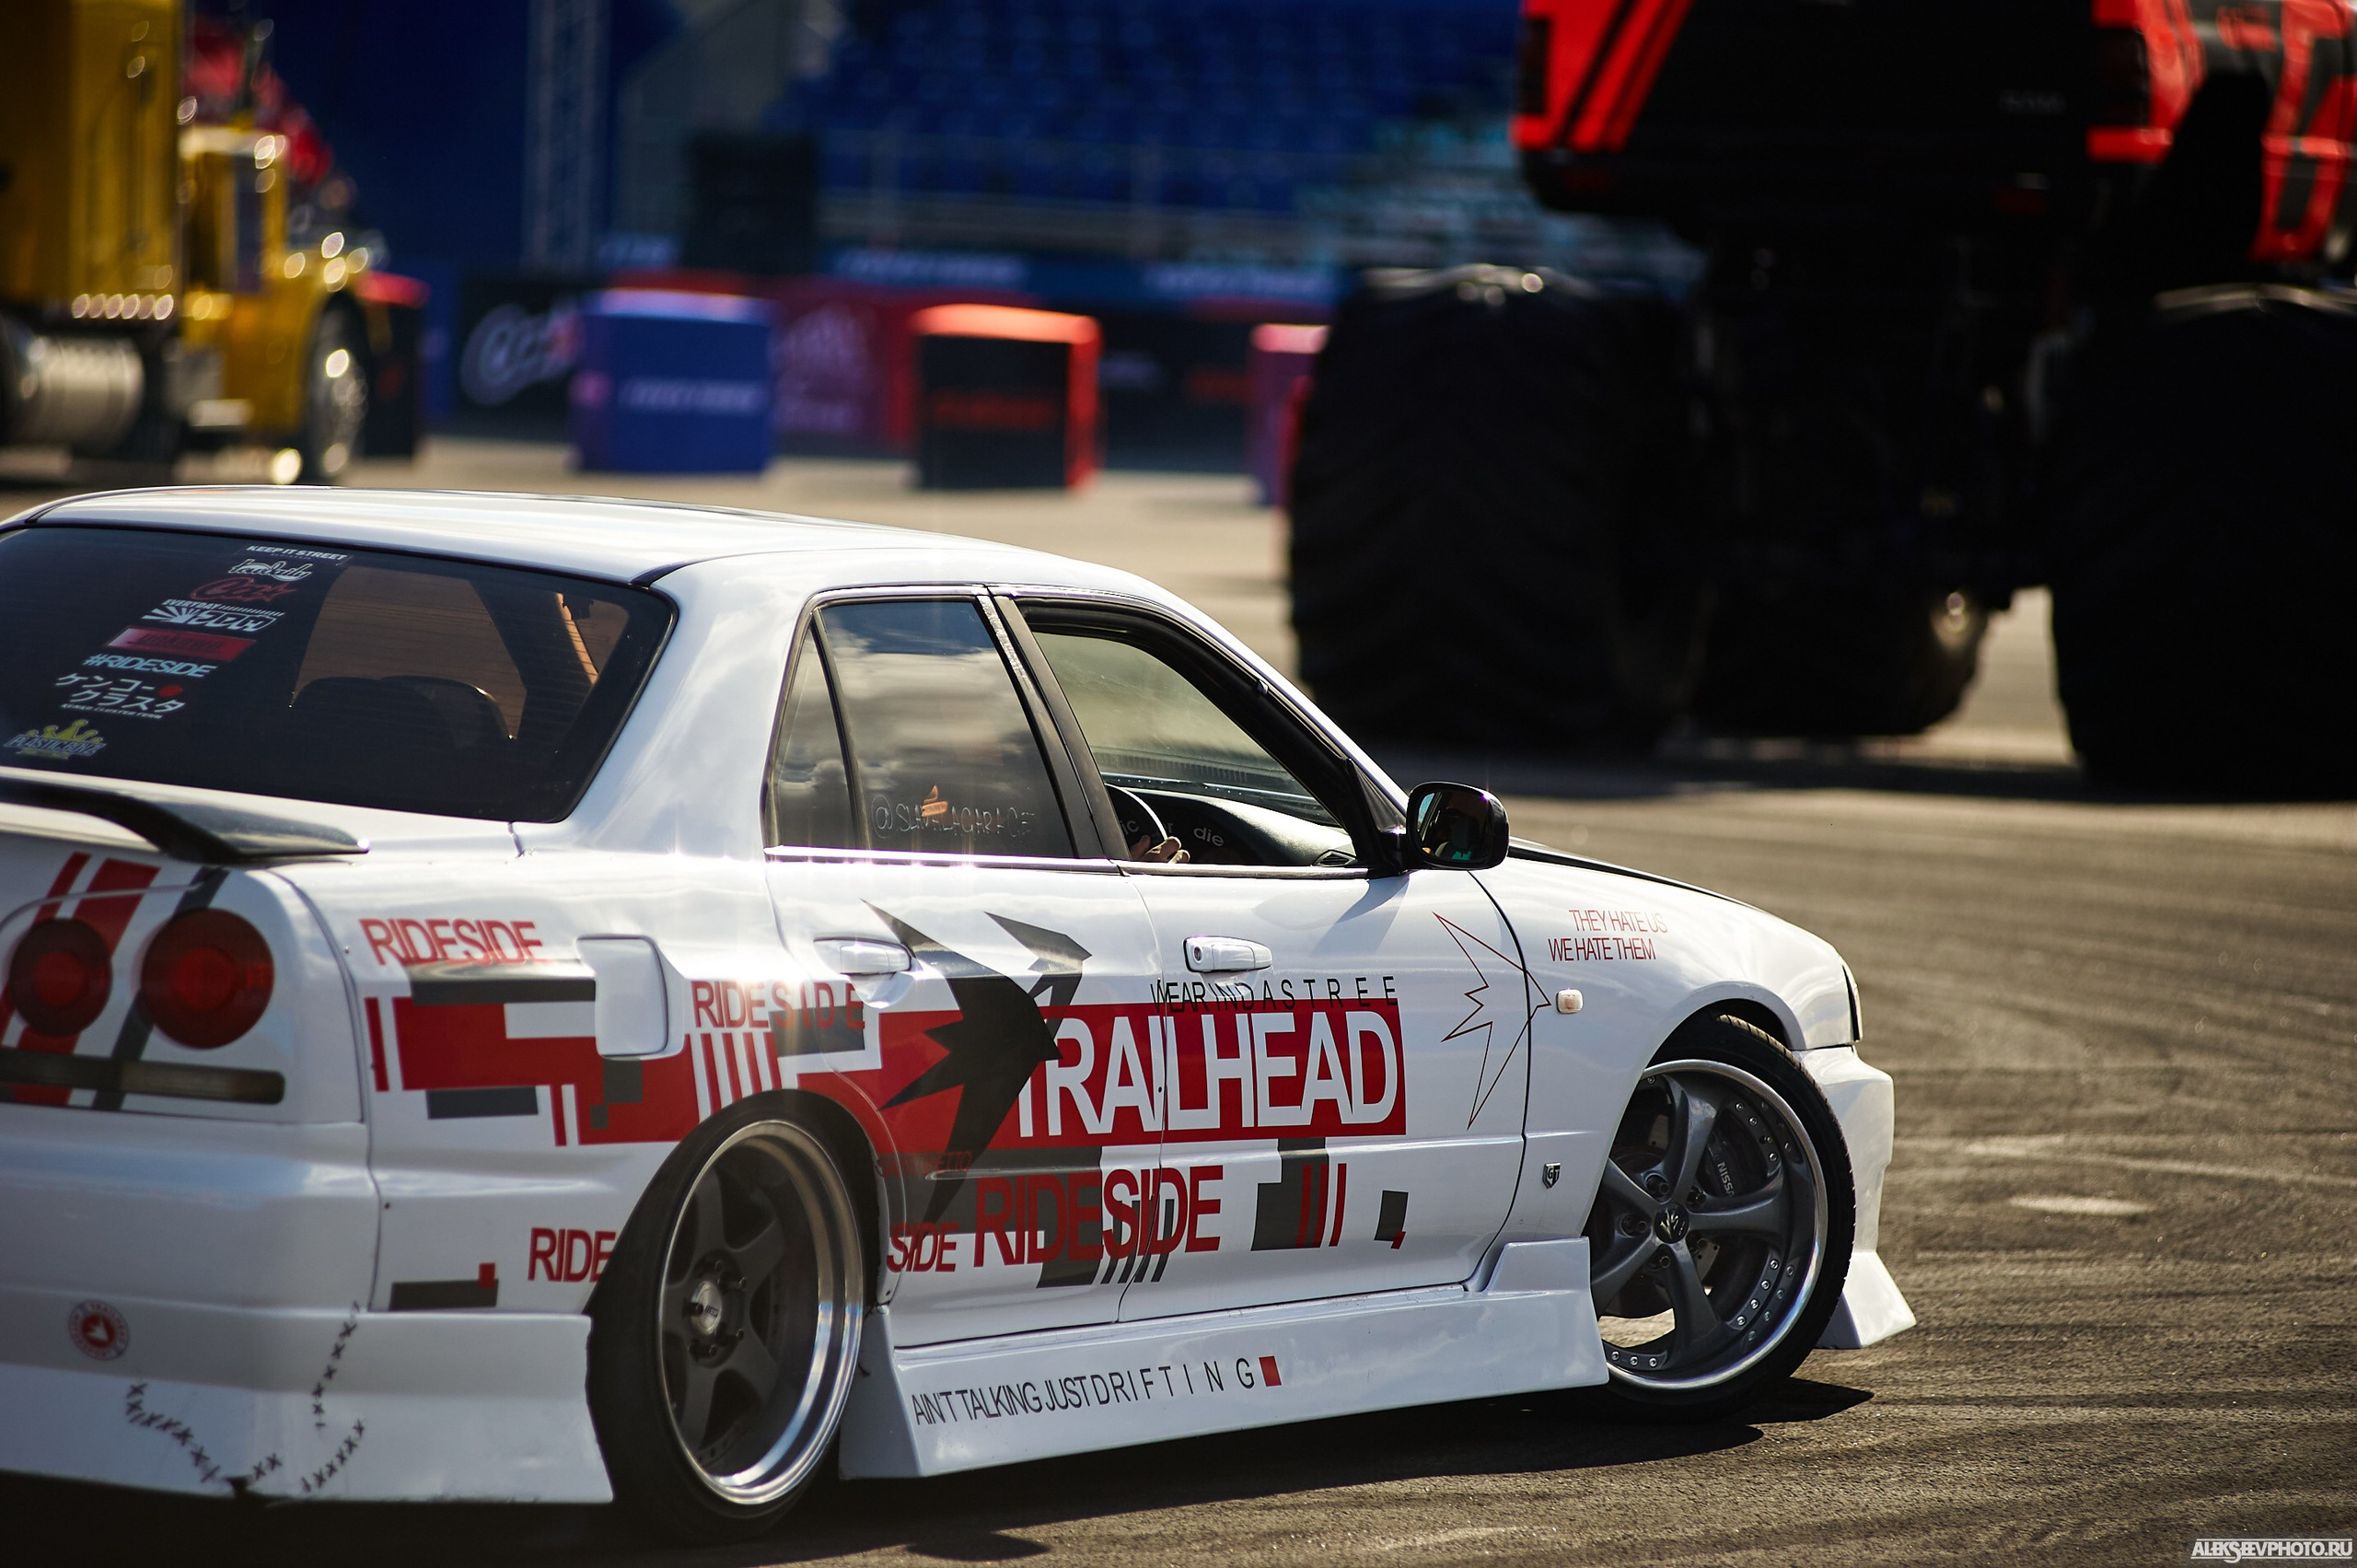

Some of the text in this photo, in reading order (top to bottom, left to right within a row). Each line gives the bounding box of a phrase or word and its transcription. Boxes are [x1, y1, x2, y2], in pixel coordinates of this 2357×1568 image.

[246, 545, 283, 553] KEEP
[295, 550, 348, 561] STREET
[161, 598, 223, 610] EVERYDAY
[82, 653, 218, 678] #RIDESIDE
[54, 672, 156, 692] ケンコー
[69, 690, 185, 713] クラスタ
[1193, 828, 1225, 847] die
[1569, 910, 1668, 934] THEY HATE US
[359, 918, 551, 967] RIDESIDE
[1548, 937, 1656, 962] WE HATE THEM
[1717, 1161, 1735, 1197] NISSA
[973, 1165, 1223, 1268] RIDESIDE
[528, 1227, 616, 1283] RIDE
[886, 1222, 960, 1273] SIDE
[911, 1357, 1256, 1426] AIN'T TALKING JUST DRIFTING
